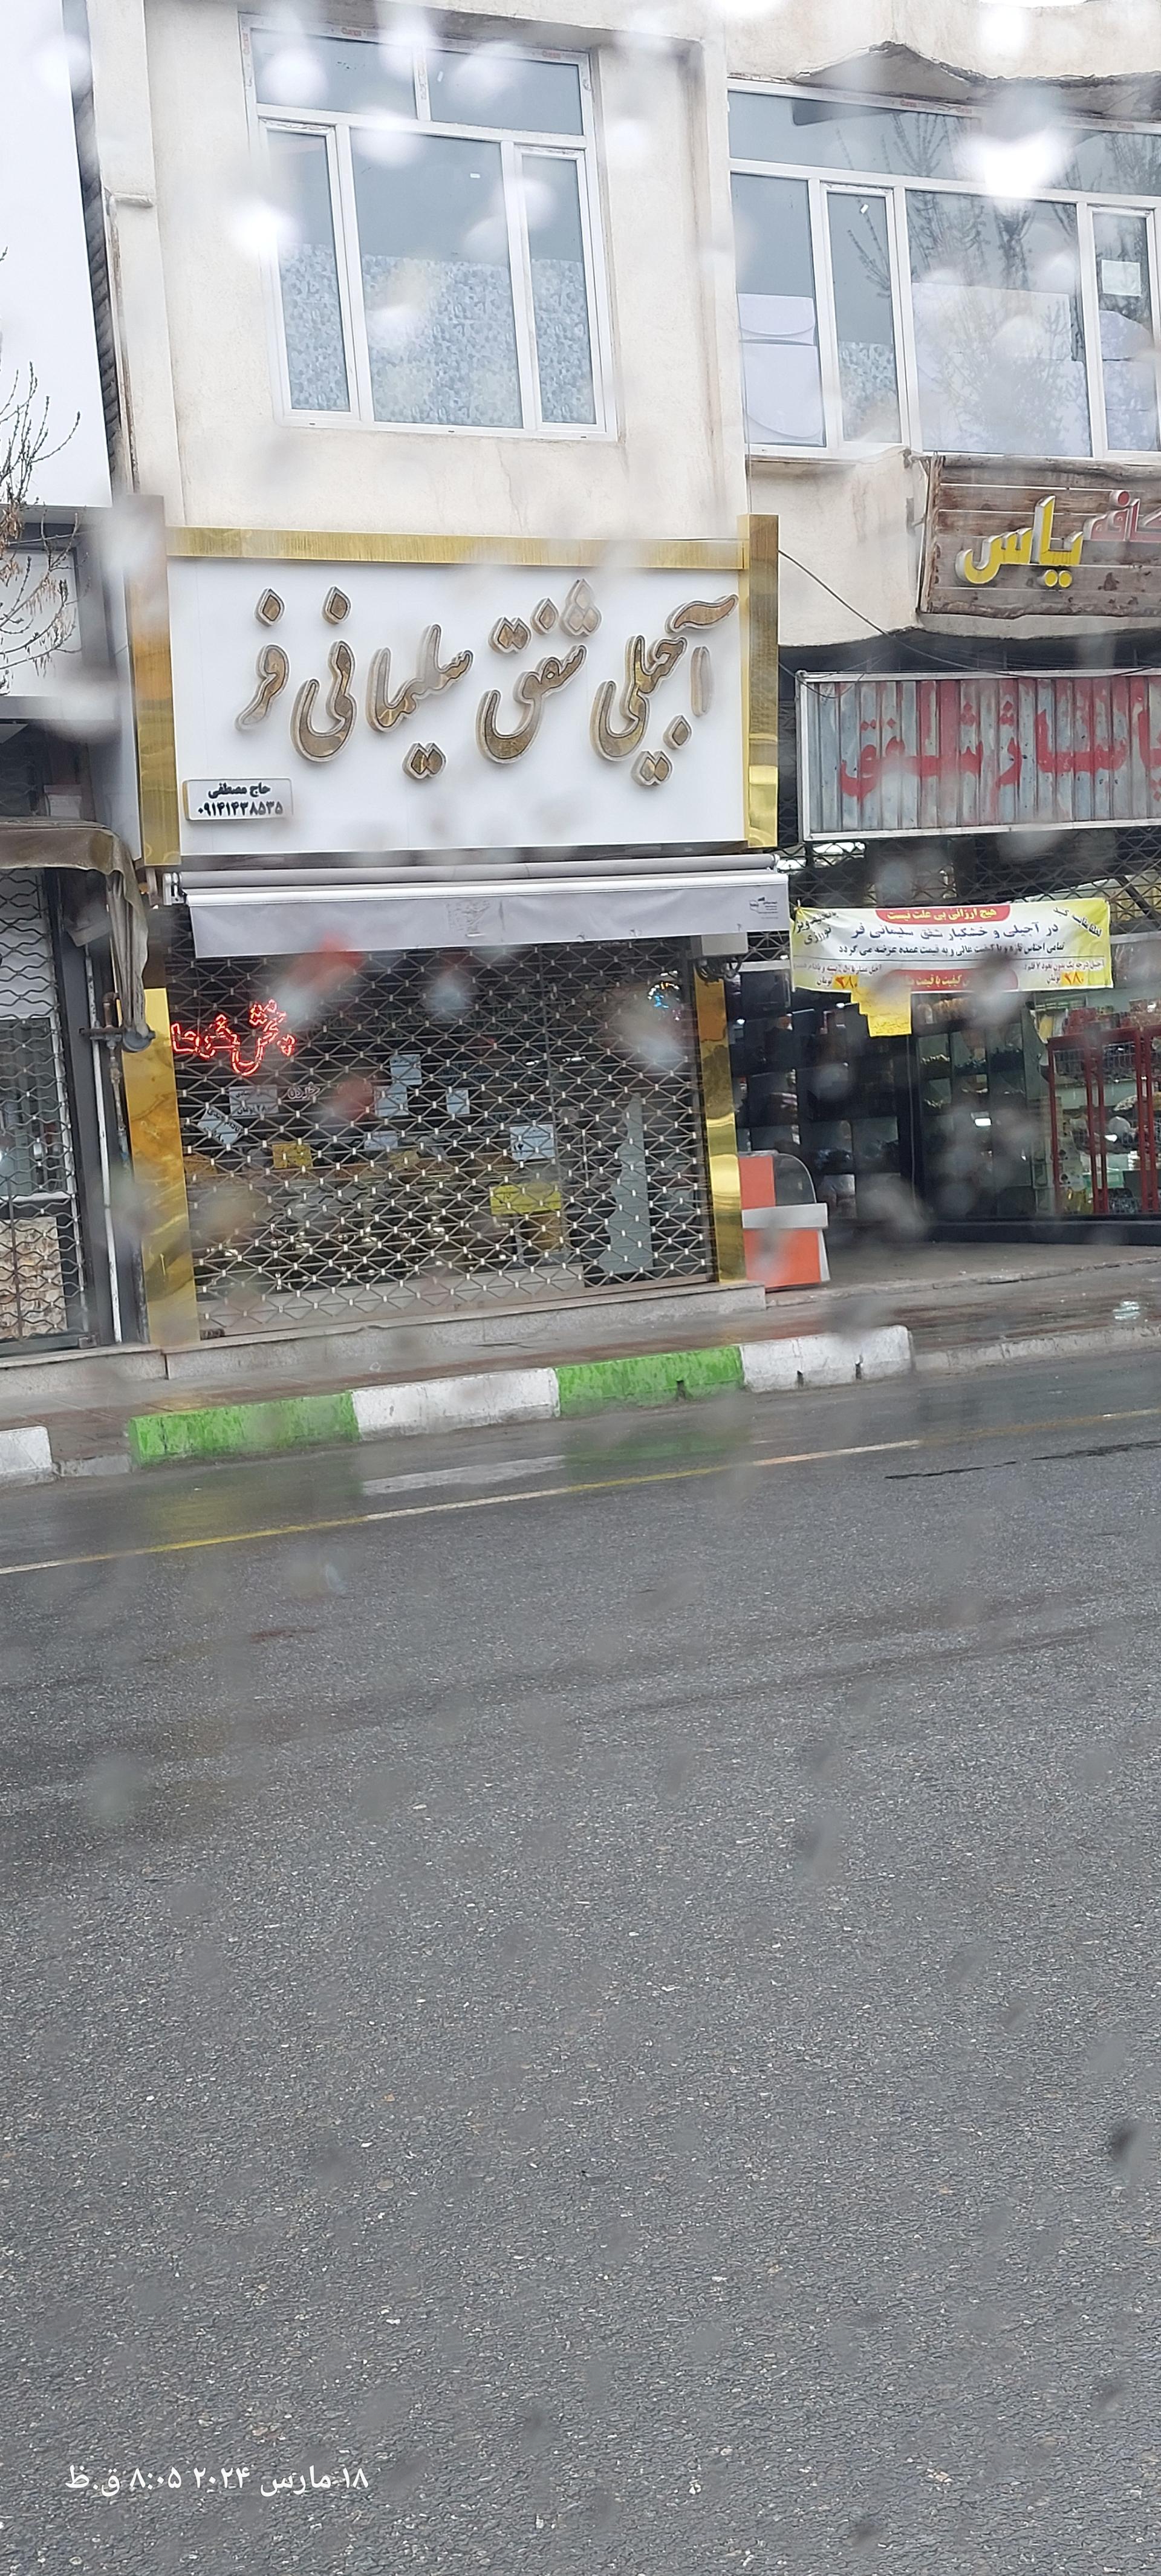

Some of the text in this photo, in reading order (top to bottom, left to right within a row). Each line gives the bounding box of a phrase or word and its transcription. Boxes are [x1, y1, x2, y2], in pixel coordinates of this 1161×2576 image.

[955, 495, 1084, 588] یاس
[235, 577, 740, 788] آجیلی شفق سلیمانی فر
[207, 781, 272, 799] حاج مصطفی
[886, 907, 997, 922] هیچ ارزانی بی علت نیست
[850, 921, 1059, 941] در آجیلی و خشکبار شفق سلیمانی فر
[1046, 942, 1066, 954] تمامی
[941, 974, 963, 988] کیفیت
